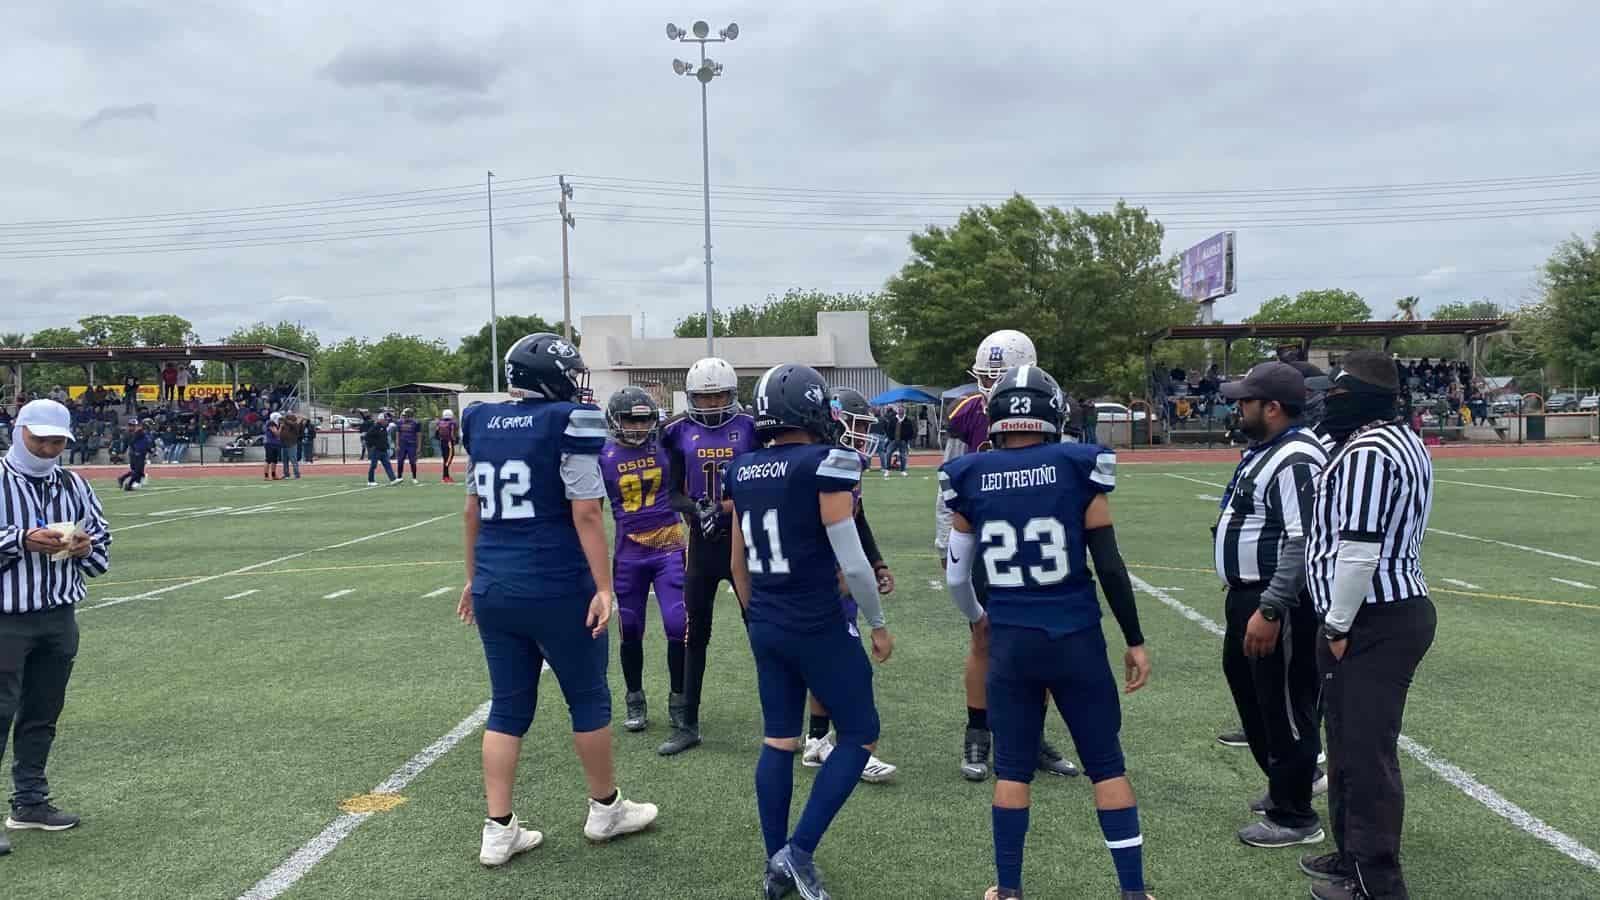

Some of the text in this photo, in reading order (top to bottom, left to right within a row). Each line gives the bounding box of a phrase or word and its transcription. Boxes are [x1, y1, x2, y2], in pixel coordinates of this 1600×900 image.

[1010, 396, 1032, 414] 23
[1000, 421, 1043, 430] Riddell
[617, 457, 656, 473] OSOS
[697, 447, 734, 458] OSOS
[736, 459, 788, 482] OBREGON
[980, 464, 1057, 492] LEO TREVIÑO
[474, 459, 535, 520] 92
[618, 466, 662, 512] 97
[741, 508, 791, 574] 11
[980, 517, 1070, 588] 23
